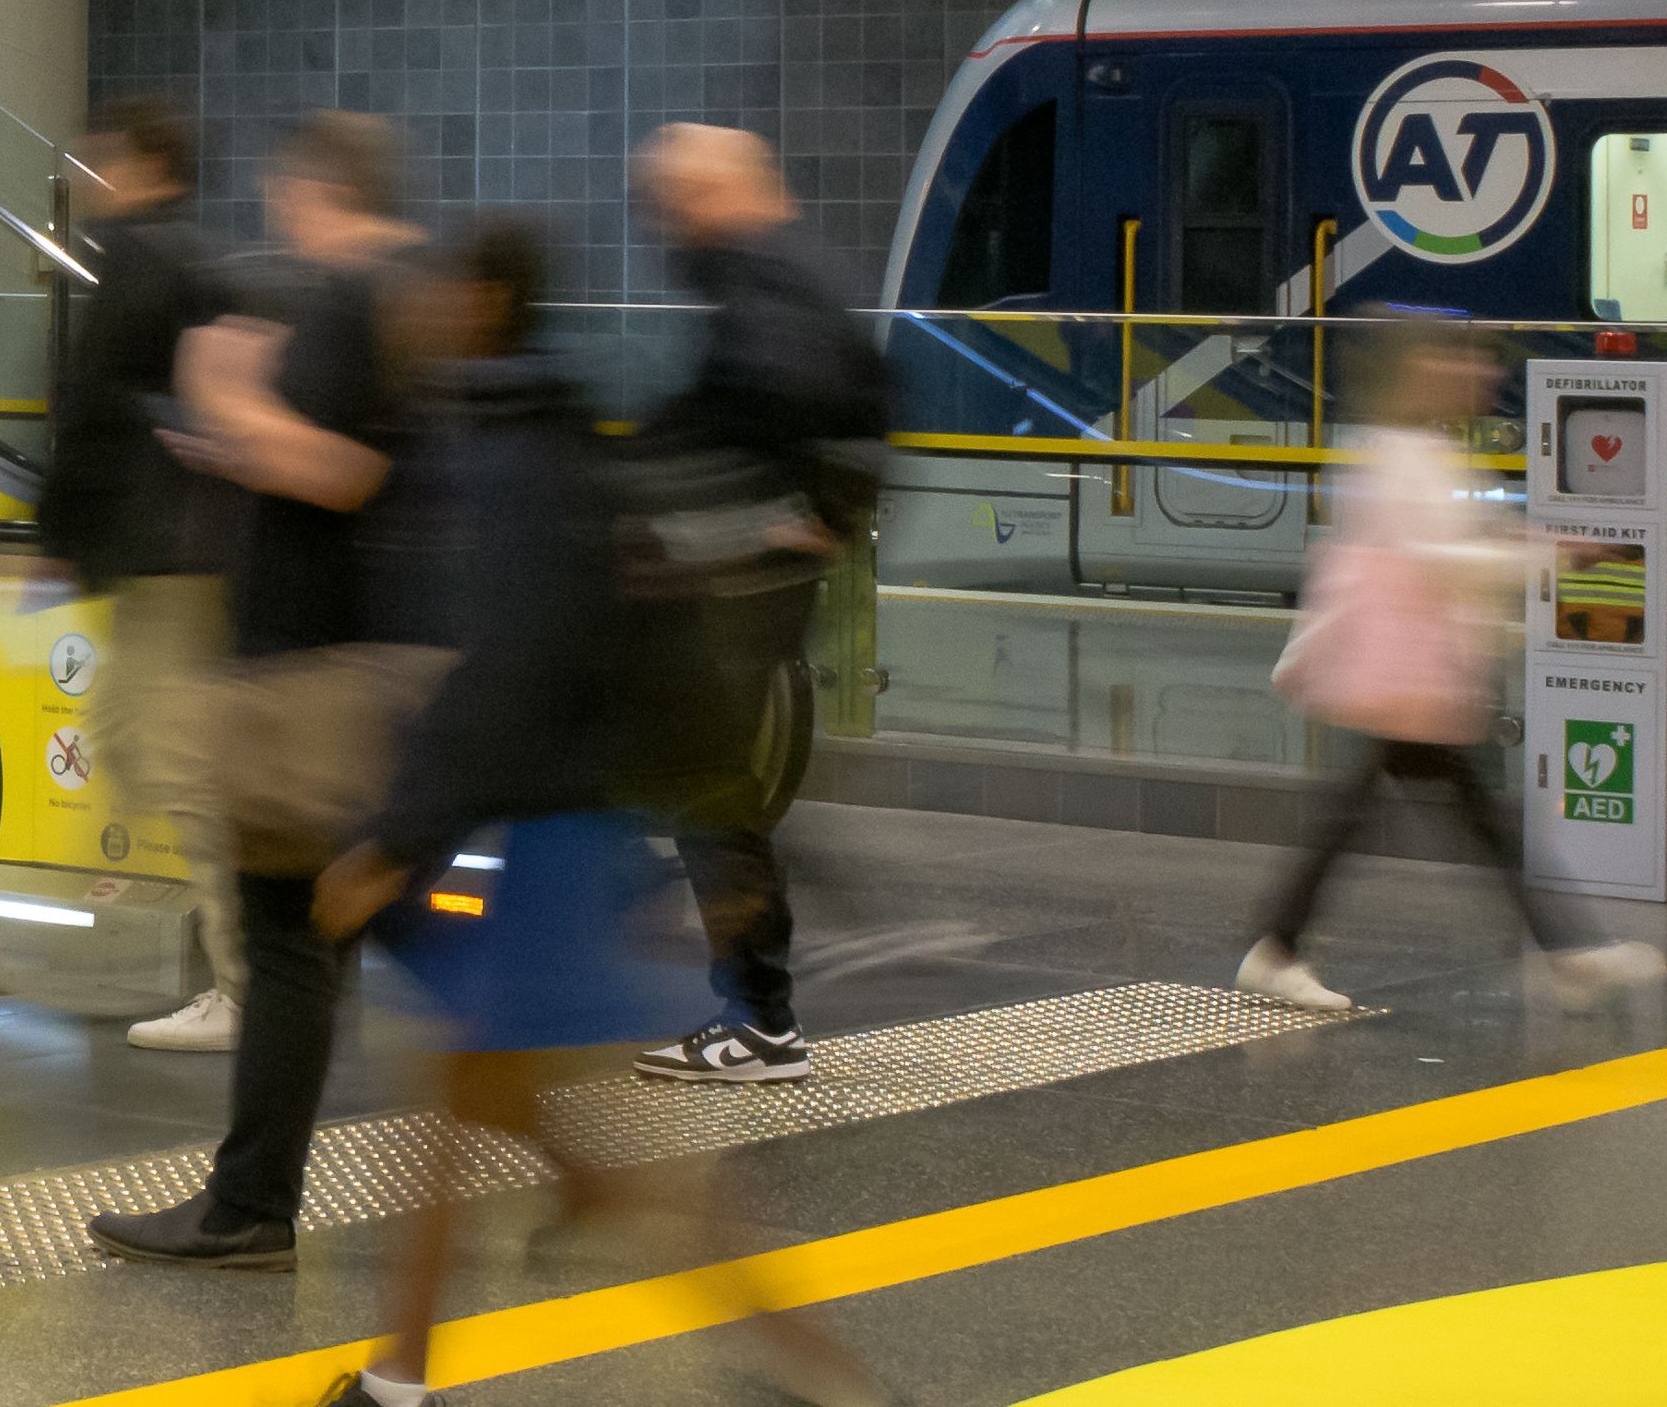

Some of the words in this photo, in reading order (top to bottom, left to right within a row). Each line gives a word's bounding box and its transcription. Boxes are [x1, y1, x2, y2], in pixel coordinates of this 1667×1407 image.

[1369, 111, 1539, 201] AT
[1546, 378, 1647, 392] DEFIBRILLATOR
[1546, 524, 1588, 537] FIRST
[1592, 526, 1617, 538] AID
[1621, 528, 1647, 539] KIT
[1545, 676, 1647, 694] EMERGENCY
[49, 798, 60, 807] No
[1573, 796, 1626, 819] AED
